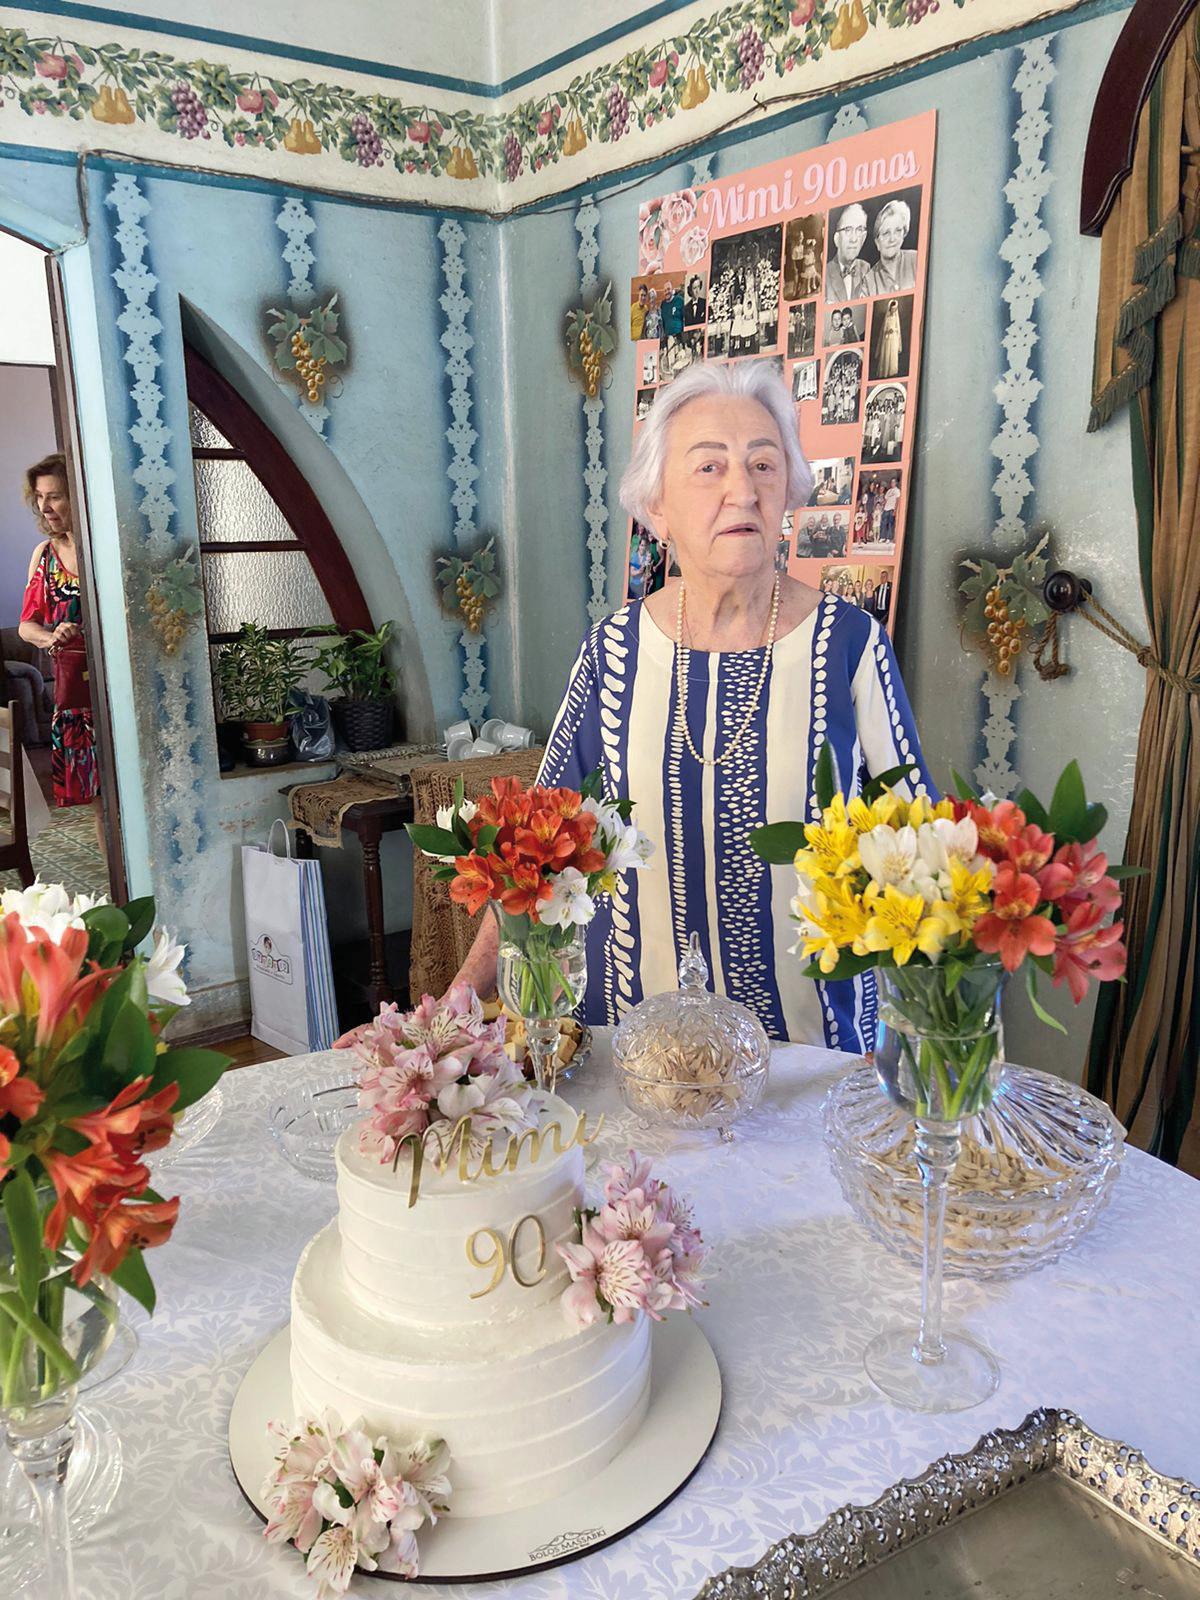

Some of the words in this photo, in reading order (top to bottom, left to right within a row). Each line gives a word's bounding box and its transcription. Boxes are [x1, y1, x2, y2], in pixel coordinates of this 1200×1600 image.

[702, 169, 800, 232] Mimi
[803, 156, 847, 204] 90
[853, 150, 920, 192] anos
[392, 1109, 605, 1209] Mimi
[465, 1214, 547, 1300] 90
[529, 1546, 560, 1562] BOLOS
